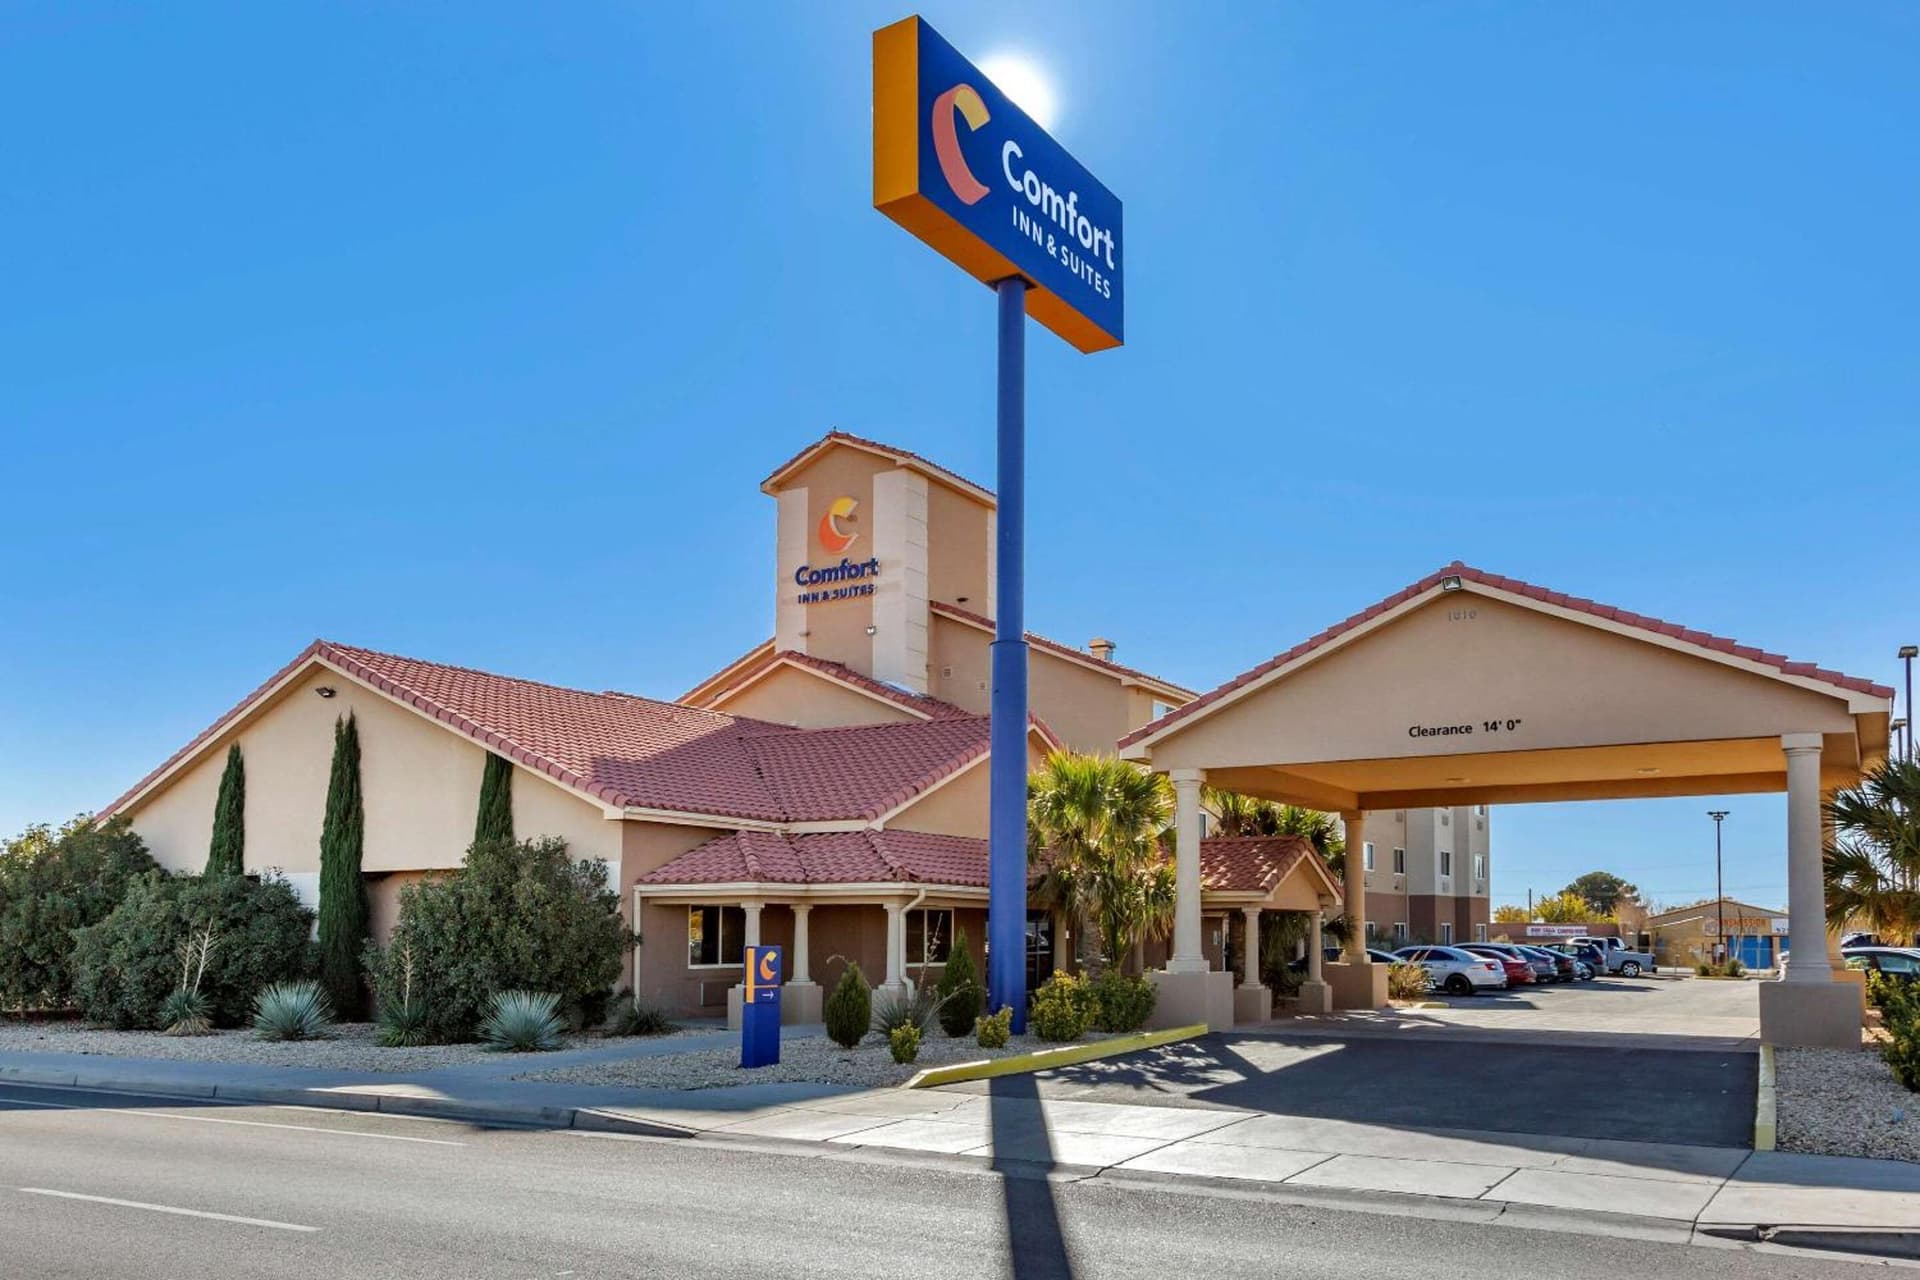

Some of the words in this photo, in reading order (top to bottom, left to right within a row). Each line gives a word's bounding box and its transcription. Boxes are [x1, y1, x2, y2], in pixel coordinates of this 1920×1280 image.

[1002, 140, 1115, 270] Comfort
[1012, 205, 1043, 247] INN
[1047, 234, 1057, 258] &
[1061, 245, 1111, 300] SUITES
[795, 557, 879, 586] Comfort
[798, 593, 819, 604] INN
[822, 590, 830, 601] &
[833, 583, 875, 600] SUITES
[1408, 724, 1473, 738] Clearance
[1483, 720, 1502, 732] 14'
[1506, 719, 1521, 731] 0"
